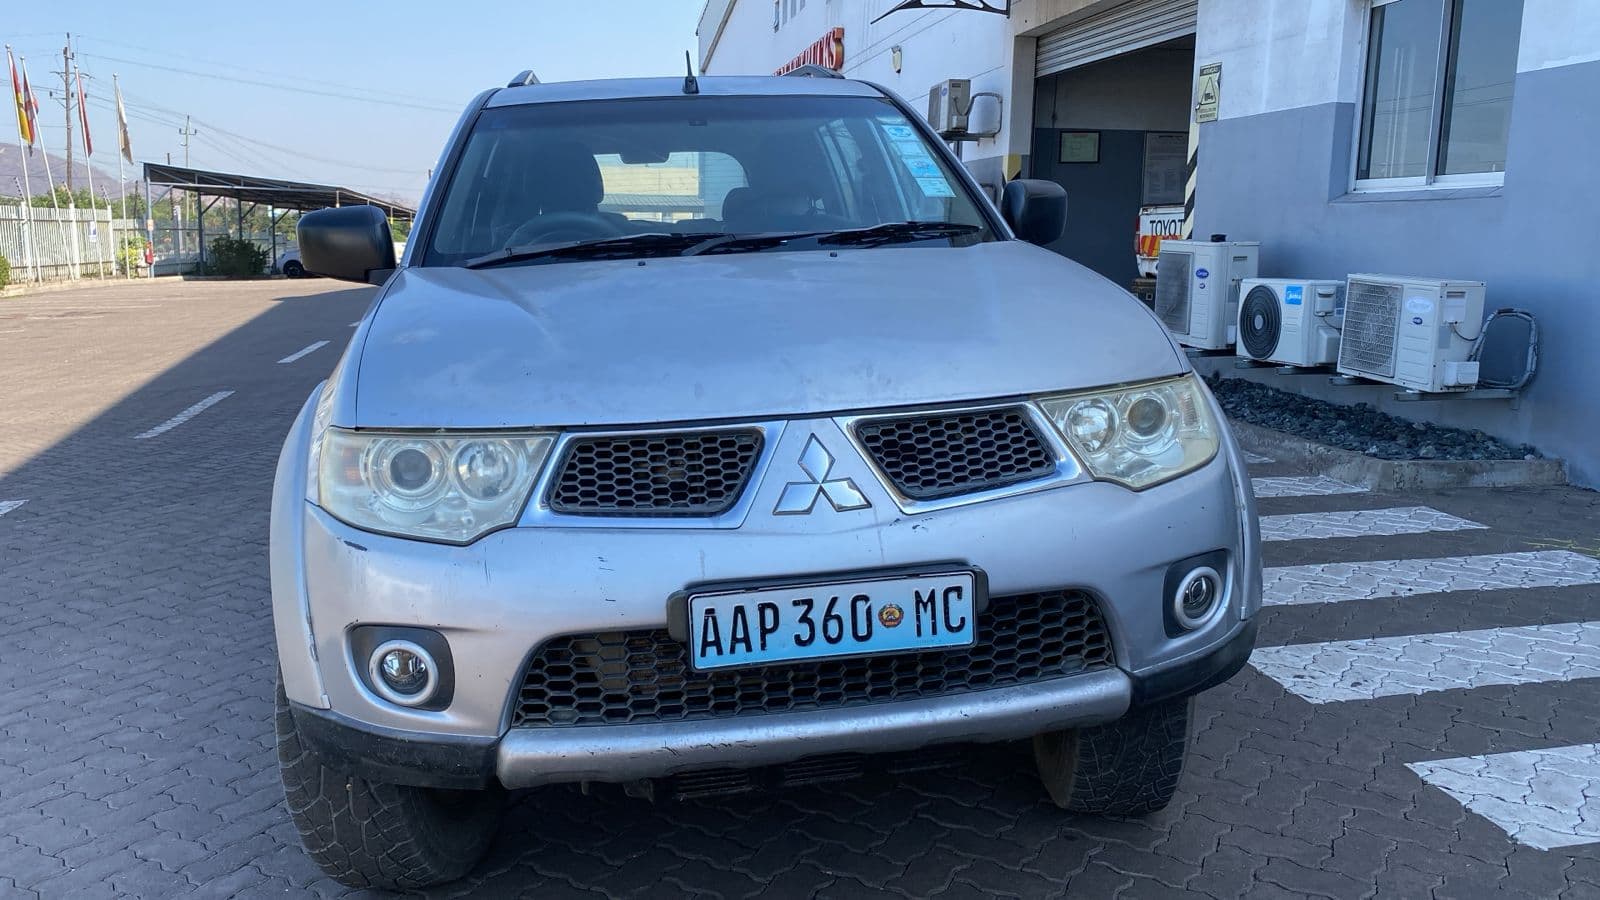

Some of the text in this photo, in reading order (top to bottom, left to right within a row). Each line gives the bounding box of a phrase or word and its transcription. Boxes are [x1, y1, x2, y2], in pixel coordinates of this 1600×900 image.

[1150, 219, 1184, 236] TOYOT
[700, 585, 967, 658] AAP 360 MC
